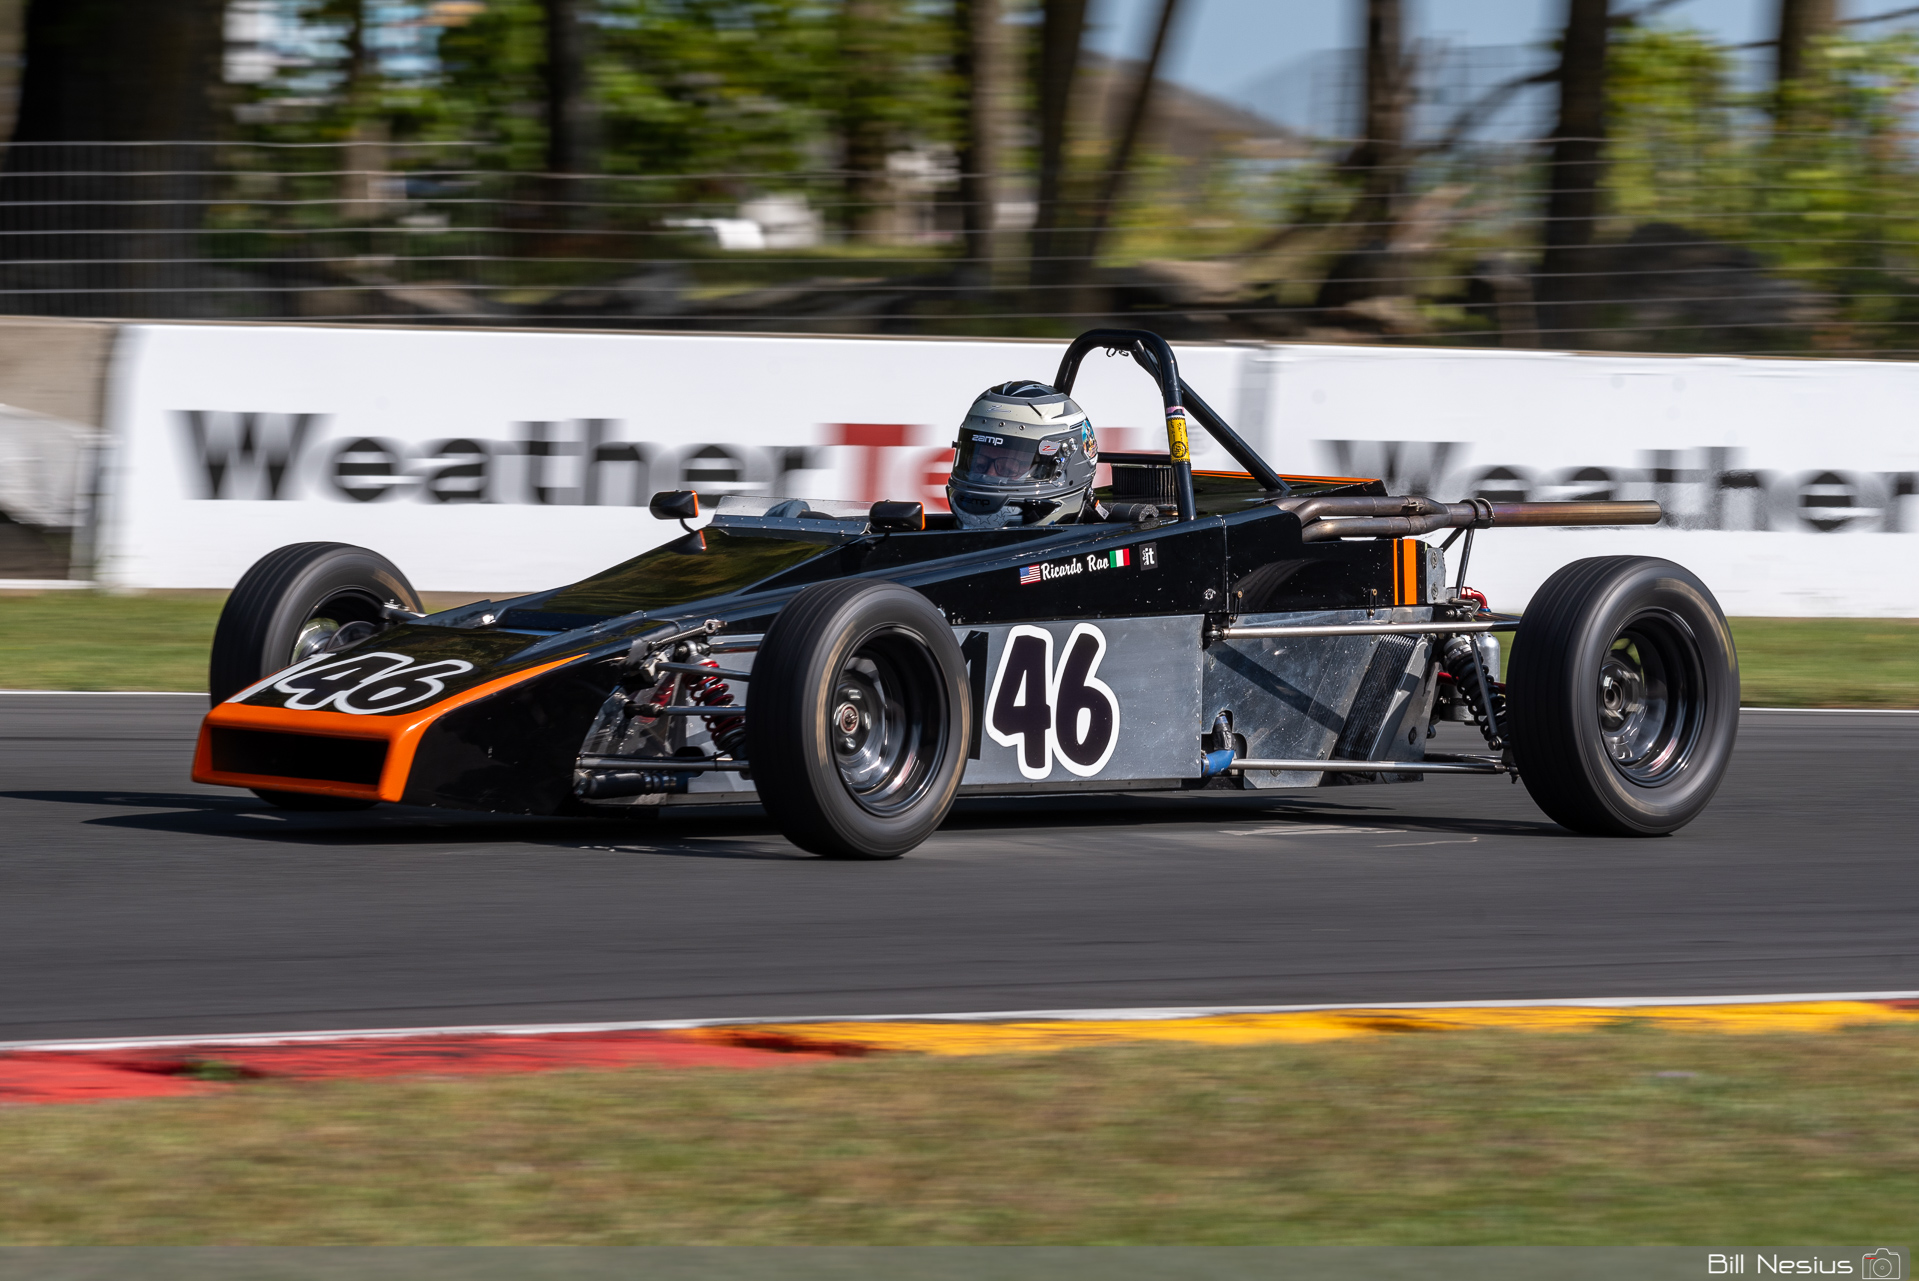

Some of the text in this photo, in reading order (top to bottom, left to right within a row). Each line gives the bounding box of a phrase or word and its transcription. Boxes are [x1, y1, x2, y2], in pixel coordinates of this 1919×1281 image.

[971, 434, 1004, 446] zamp
[1040, 554, 1110, 581] Ricardo Rao
